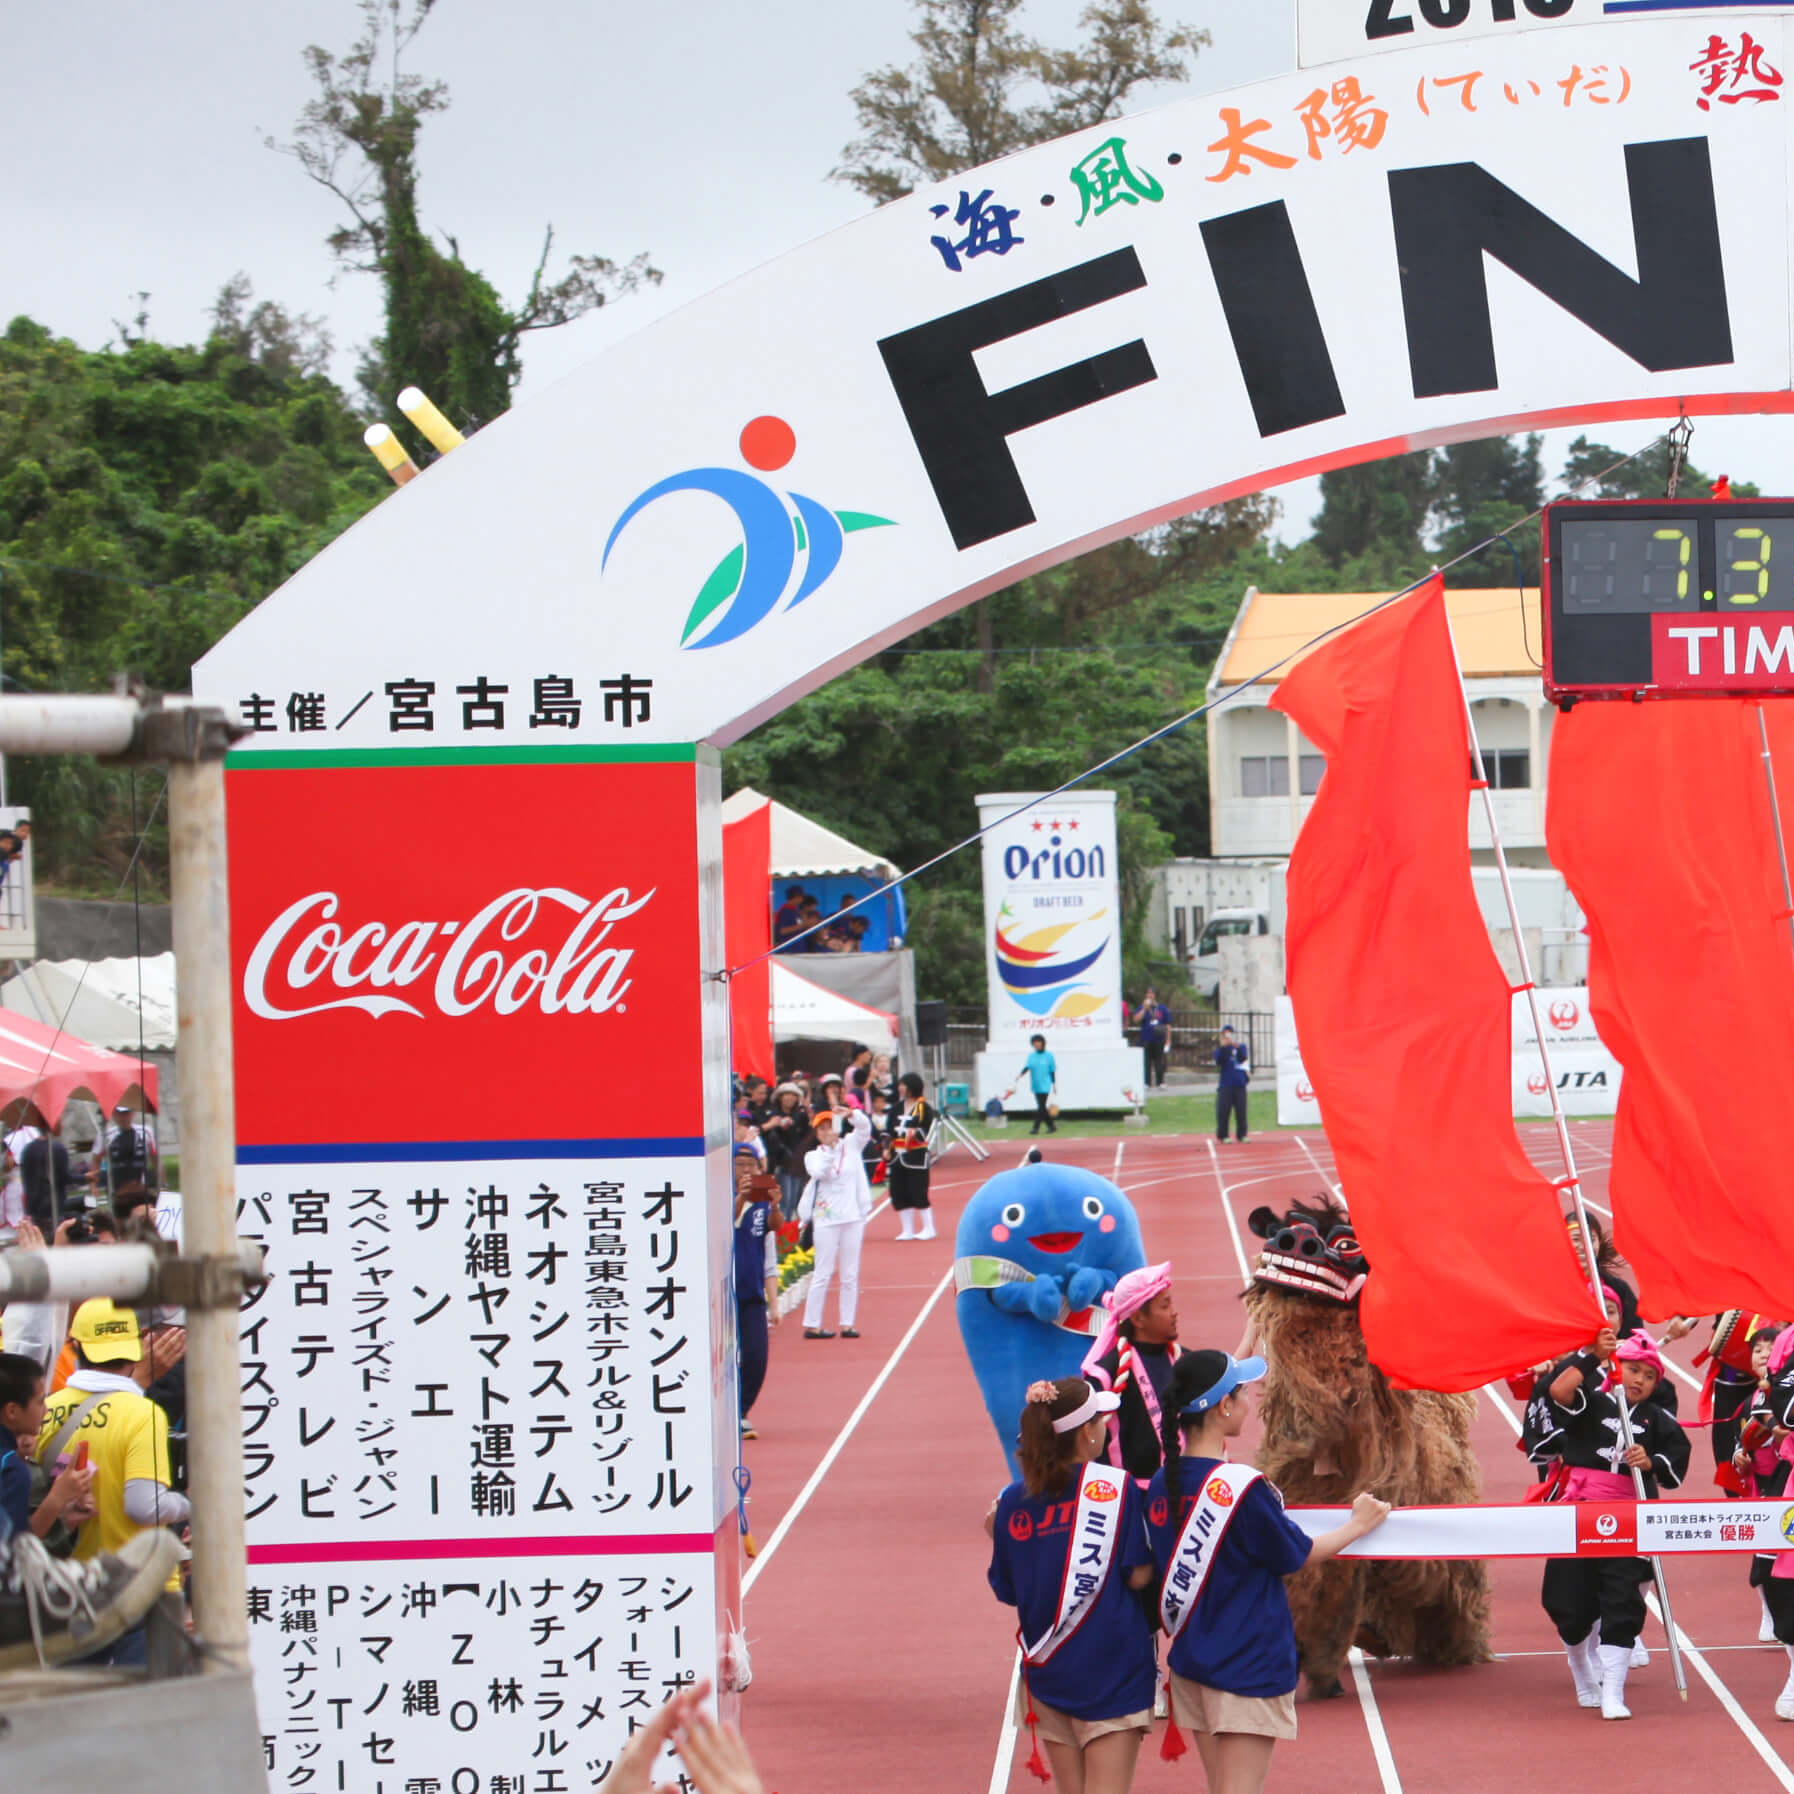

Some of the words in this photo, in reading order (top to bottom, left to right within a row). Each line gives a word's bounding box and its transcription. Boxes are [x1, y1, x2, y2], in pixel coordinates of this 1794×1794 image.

[243, 886, 658, 1021] Coca-Cola
[1004, 834, 1106, 881] Orion
[1557, 1071, 1608, 1088] JTA
[287, 1189, 339, 1519] 宮古テレビ
[406, 1188, 454, 1515] サンエー
[464, 1185, 515, 1517] 沖縄ヤマト運輸
[525, 1183, 574, 1513] ネオシステム
[641, 1181, 693, 1511] オリオンビール
[1719, 1524, 1756, 1542] 優勝
[280, 1584, 323, 1794] 沖縄パナソニック
